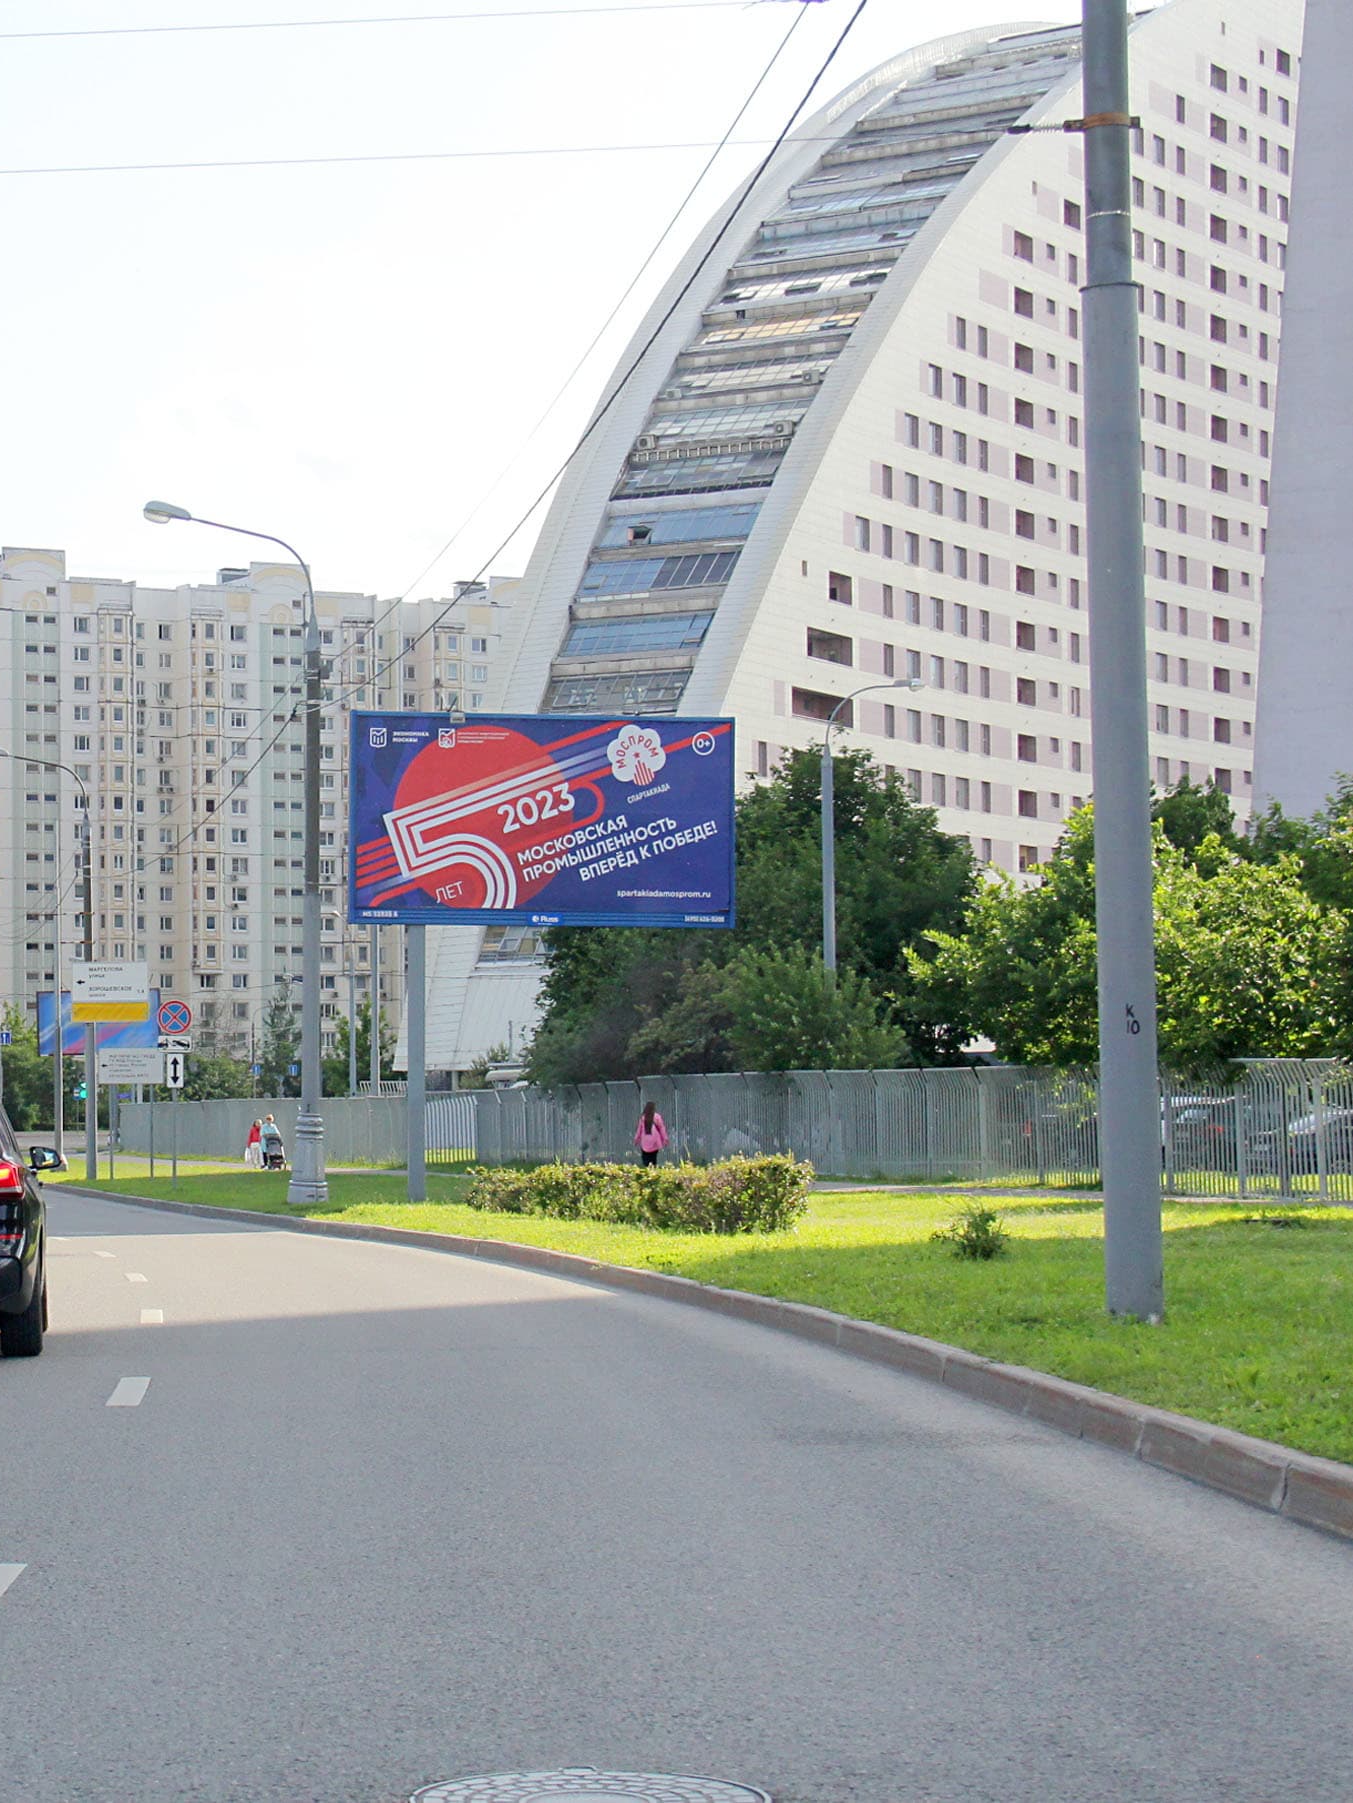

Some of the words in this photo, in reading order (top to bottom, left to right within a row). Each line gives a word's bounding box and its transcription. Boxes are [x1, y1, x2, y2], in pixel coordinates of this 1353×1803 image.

[615, 735, 659, 769] МОСПРОМ
[696, 738, 711, 749] 0+
[497, 782, 576, 834] 2023
[626, 783, 671, 804] СПАРТАКИАДА
[517, 814, 628, 865] МОСКОВСКАЯ
[522, 817, 677, 882] ПРОМЫШЛЕННОСТЬ
[578, 850, 639, 882] ВПЕРЁД
[639, 844, 652, 860] К
[653, 820, 718, 855] ПОБЕДЕ!
[435, 880, 464, 904] ЛЕТ
[616, 889, 712, 899] spartakiadamosprom.ru
[1126, 1019, 1140, 1035] 10
